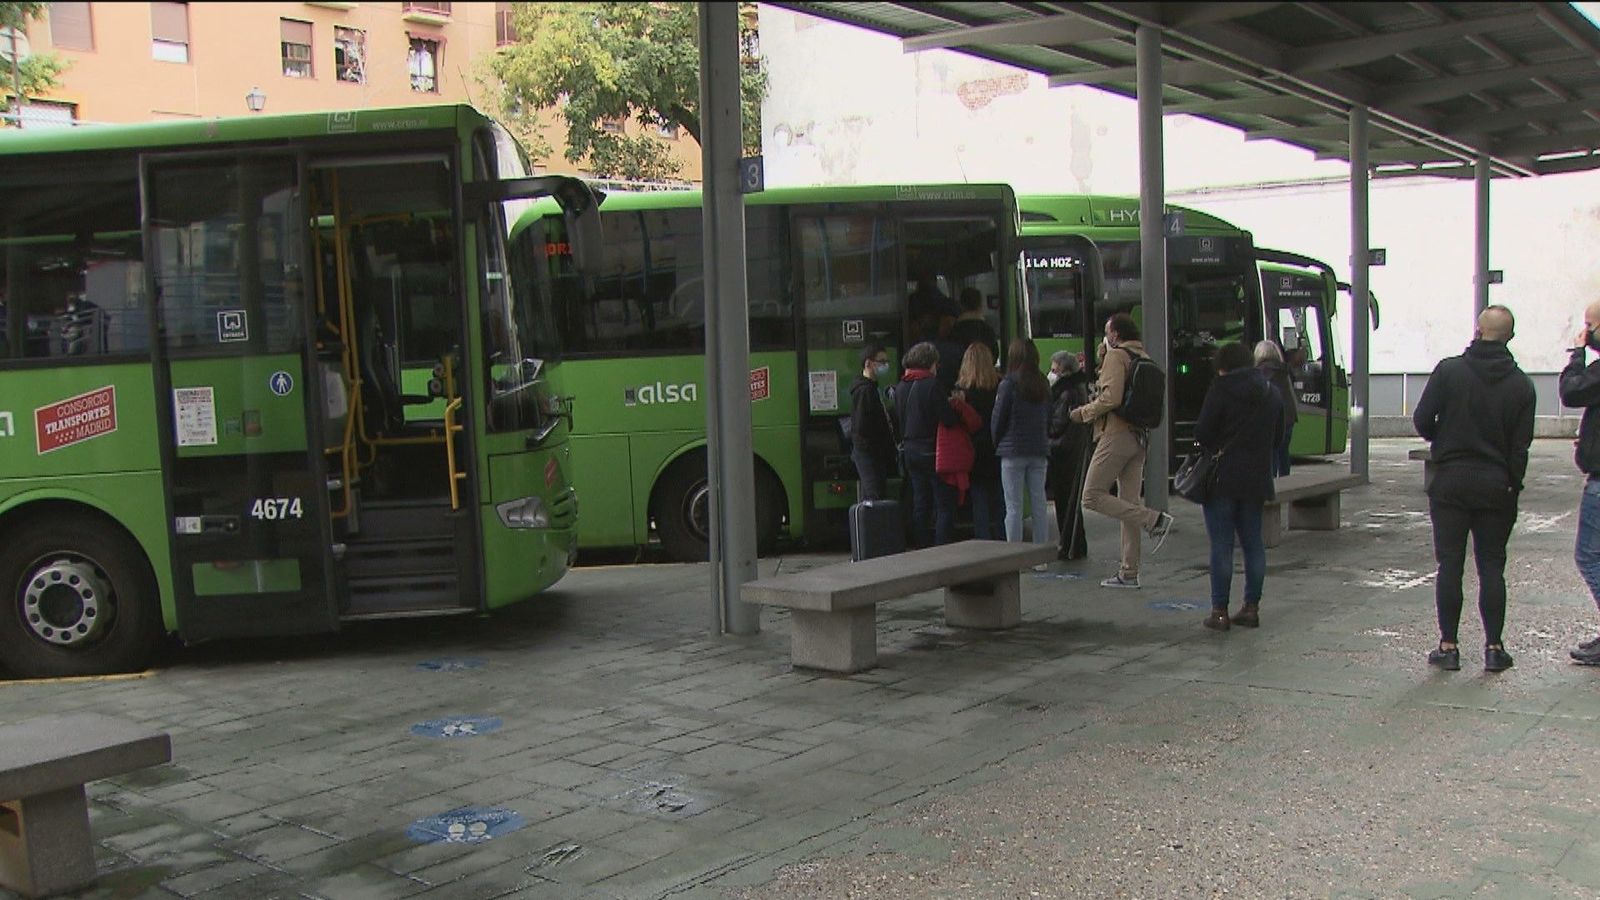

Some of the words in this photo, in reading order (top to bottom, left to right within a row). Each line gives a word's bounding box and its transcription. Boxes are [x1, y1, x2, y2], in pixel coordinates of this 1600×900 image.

[748, 163, 759, 188] 3
[1170, 218, 1180, 234] 4
[1033, 258, 1048, 268] LA
[1050, 257, 1072, 268] HOZ
[638, 381, 697, 404] alsa
[56, 391, 110, 418] CONSORCIO
[44, 404, 111, 435] TRANSPORTES
[75, 418, 112, 439] MADRID
[251, 497, 304, 520] 4674
